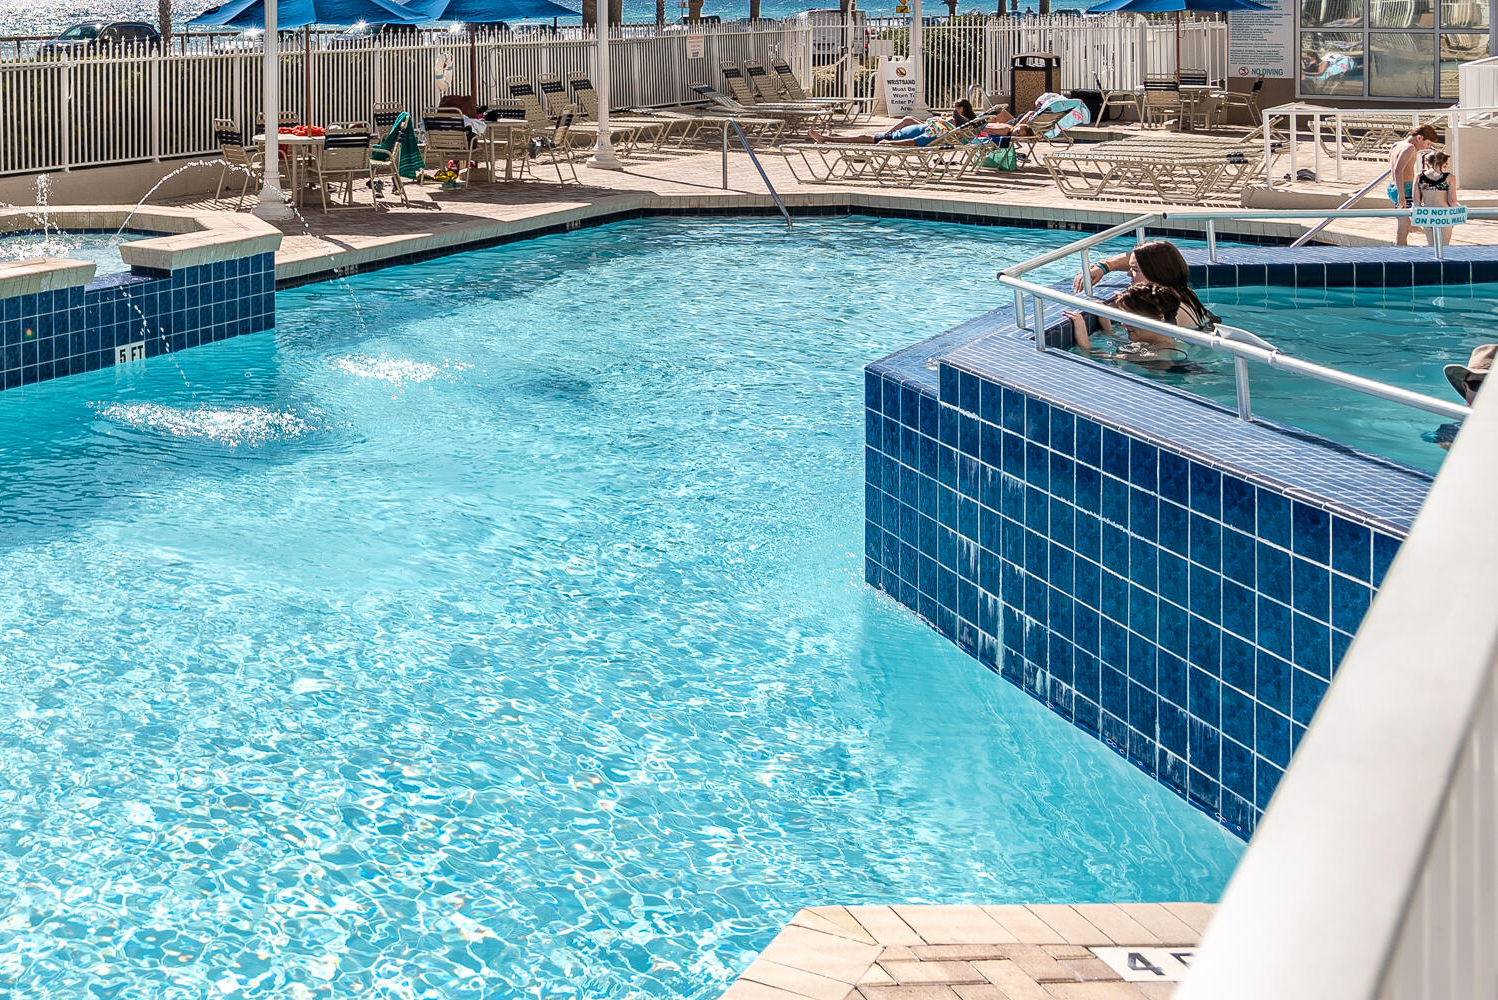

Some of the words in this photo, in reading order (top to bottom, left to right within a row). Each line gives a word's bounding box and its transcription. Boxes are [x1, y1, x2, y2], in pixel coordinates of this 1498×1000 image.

[1449, 207, 1465, 215] CLIMB
[120, 349, 126, 363] 5
[132, 345, 143, 361] FT
[1128, 952, 1165, 975] 4
